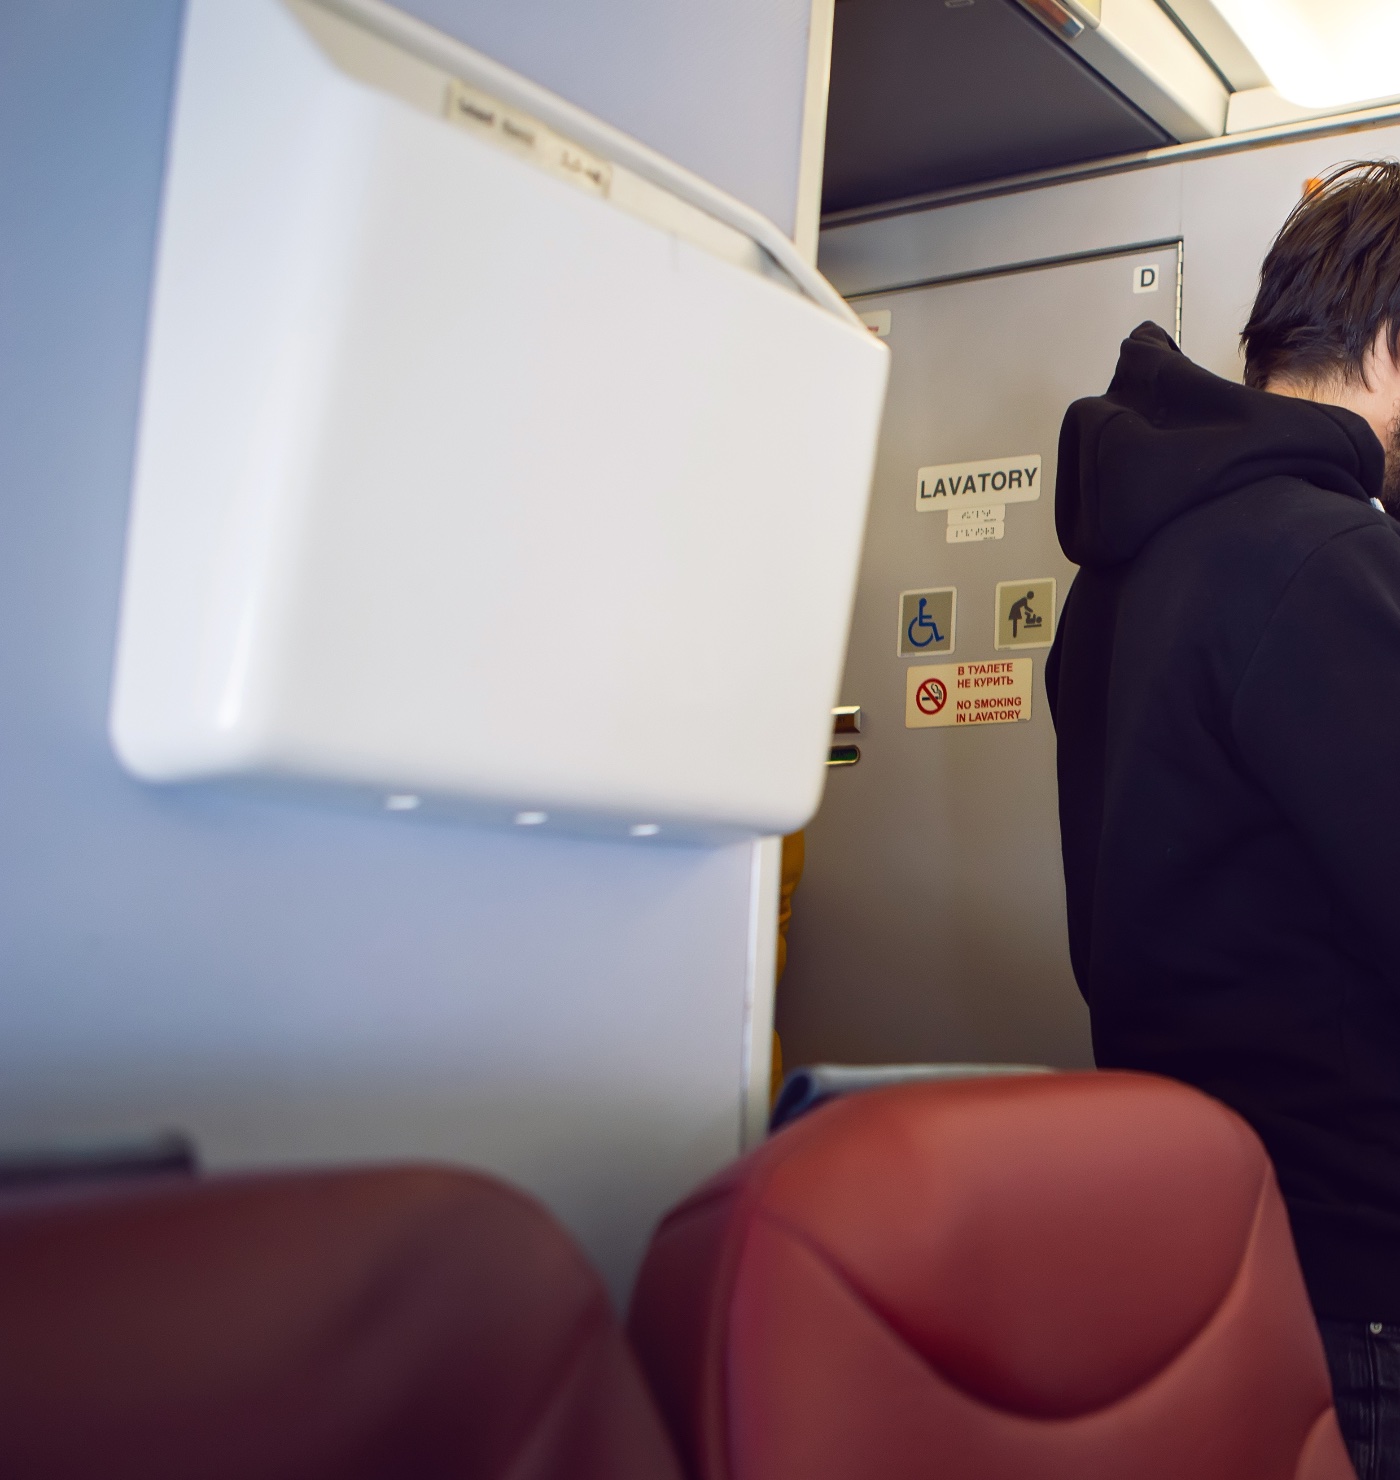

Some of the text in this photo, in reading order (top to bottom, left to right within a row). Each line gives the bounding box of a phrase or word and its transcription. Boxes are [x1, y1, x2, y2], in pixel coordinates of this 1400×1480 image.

[1140, 268, 1156, 288] D
[920, 466, 1038, 499] LAVATORY
[957, 662, 1014, 676] В ТУАЛЕТЕ
[957, 676, 1014, 689] НЕ КУРИТЬ
[956, 697, 1022, 710] NO SMOKING
[956, 710, 1021, 723] IN LAVATORY
